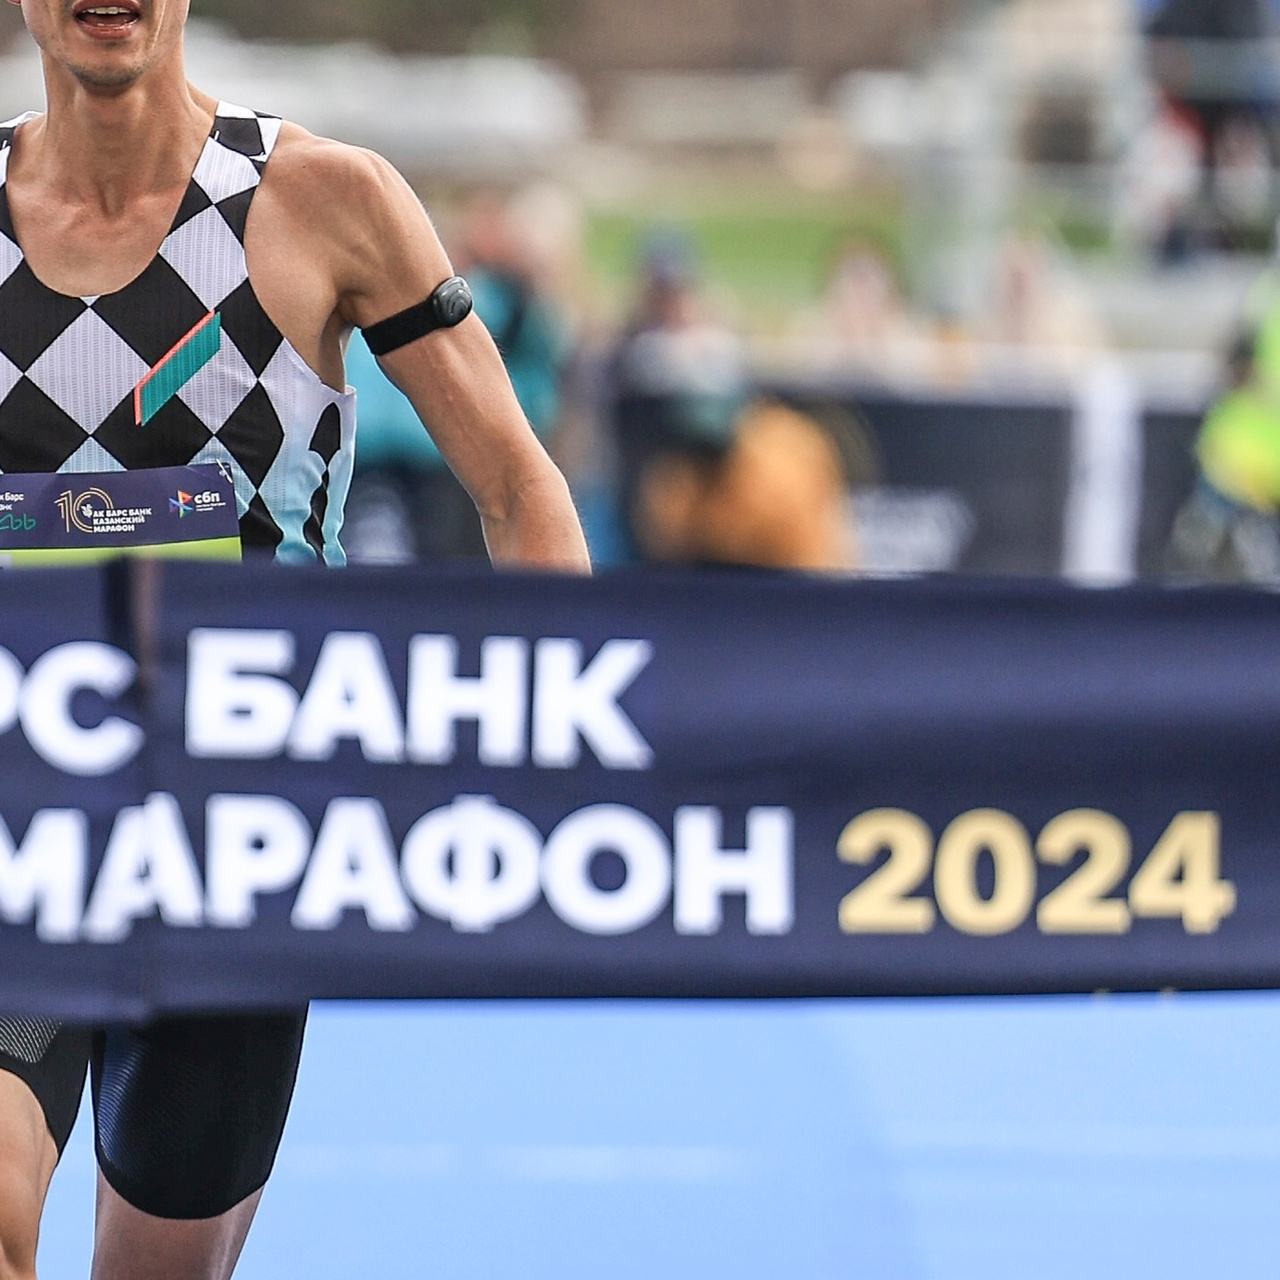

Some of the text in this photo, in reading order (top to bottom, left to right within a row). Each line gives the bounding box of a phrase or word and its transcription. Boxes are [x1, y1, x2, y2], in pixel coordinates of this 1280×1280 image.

[106, 509, 128, 517] БАРС
[93, 515, 146, 525] КАЗАНСКИЙ
[93, 524, 135, 533] МАРАФОН
[183, 626, 655, 770] БАНК
[835, 805, 1238, 938] 2024
